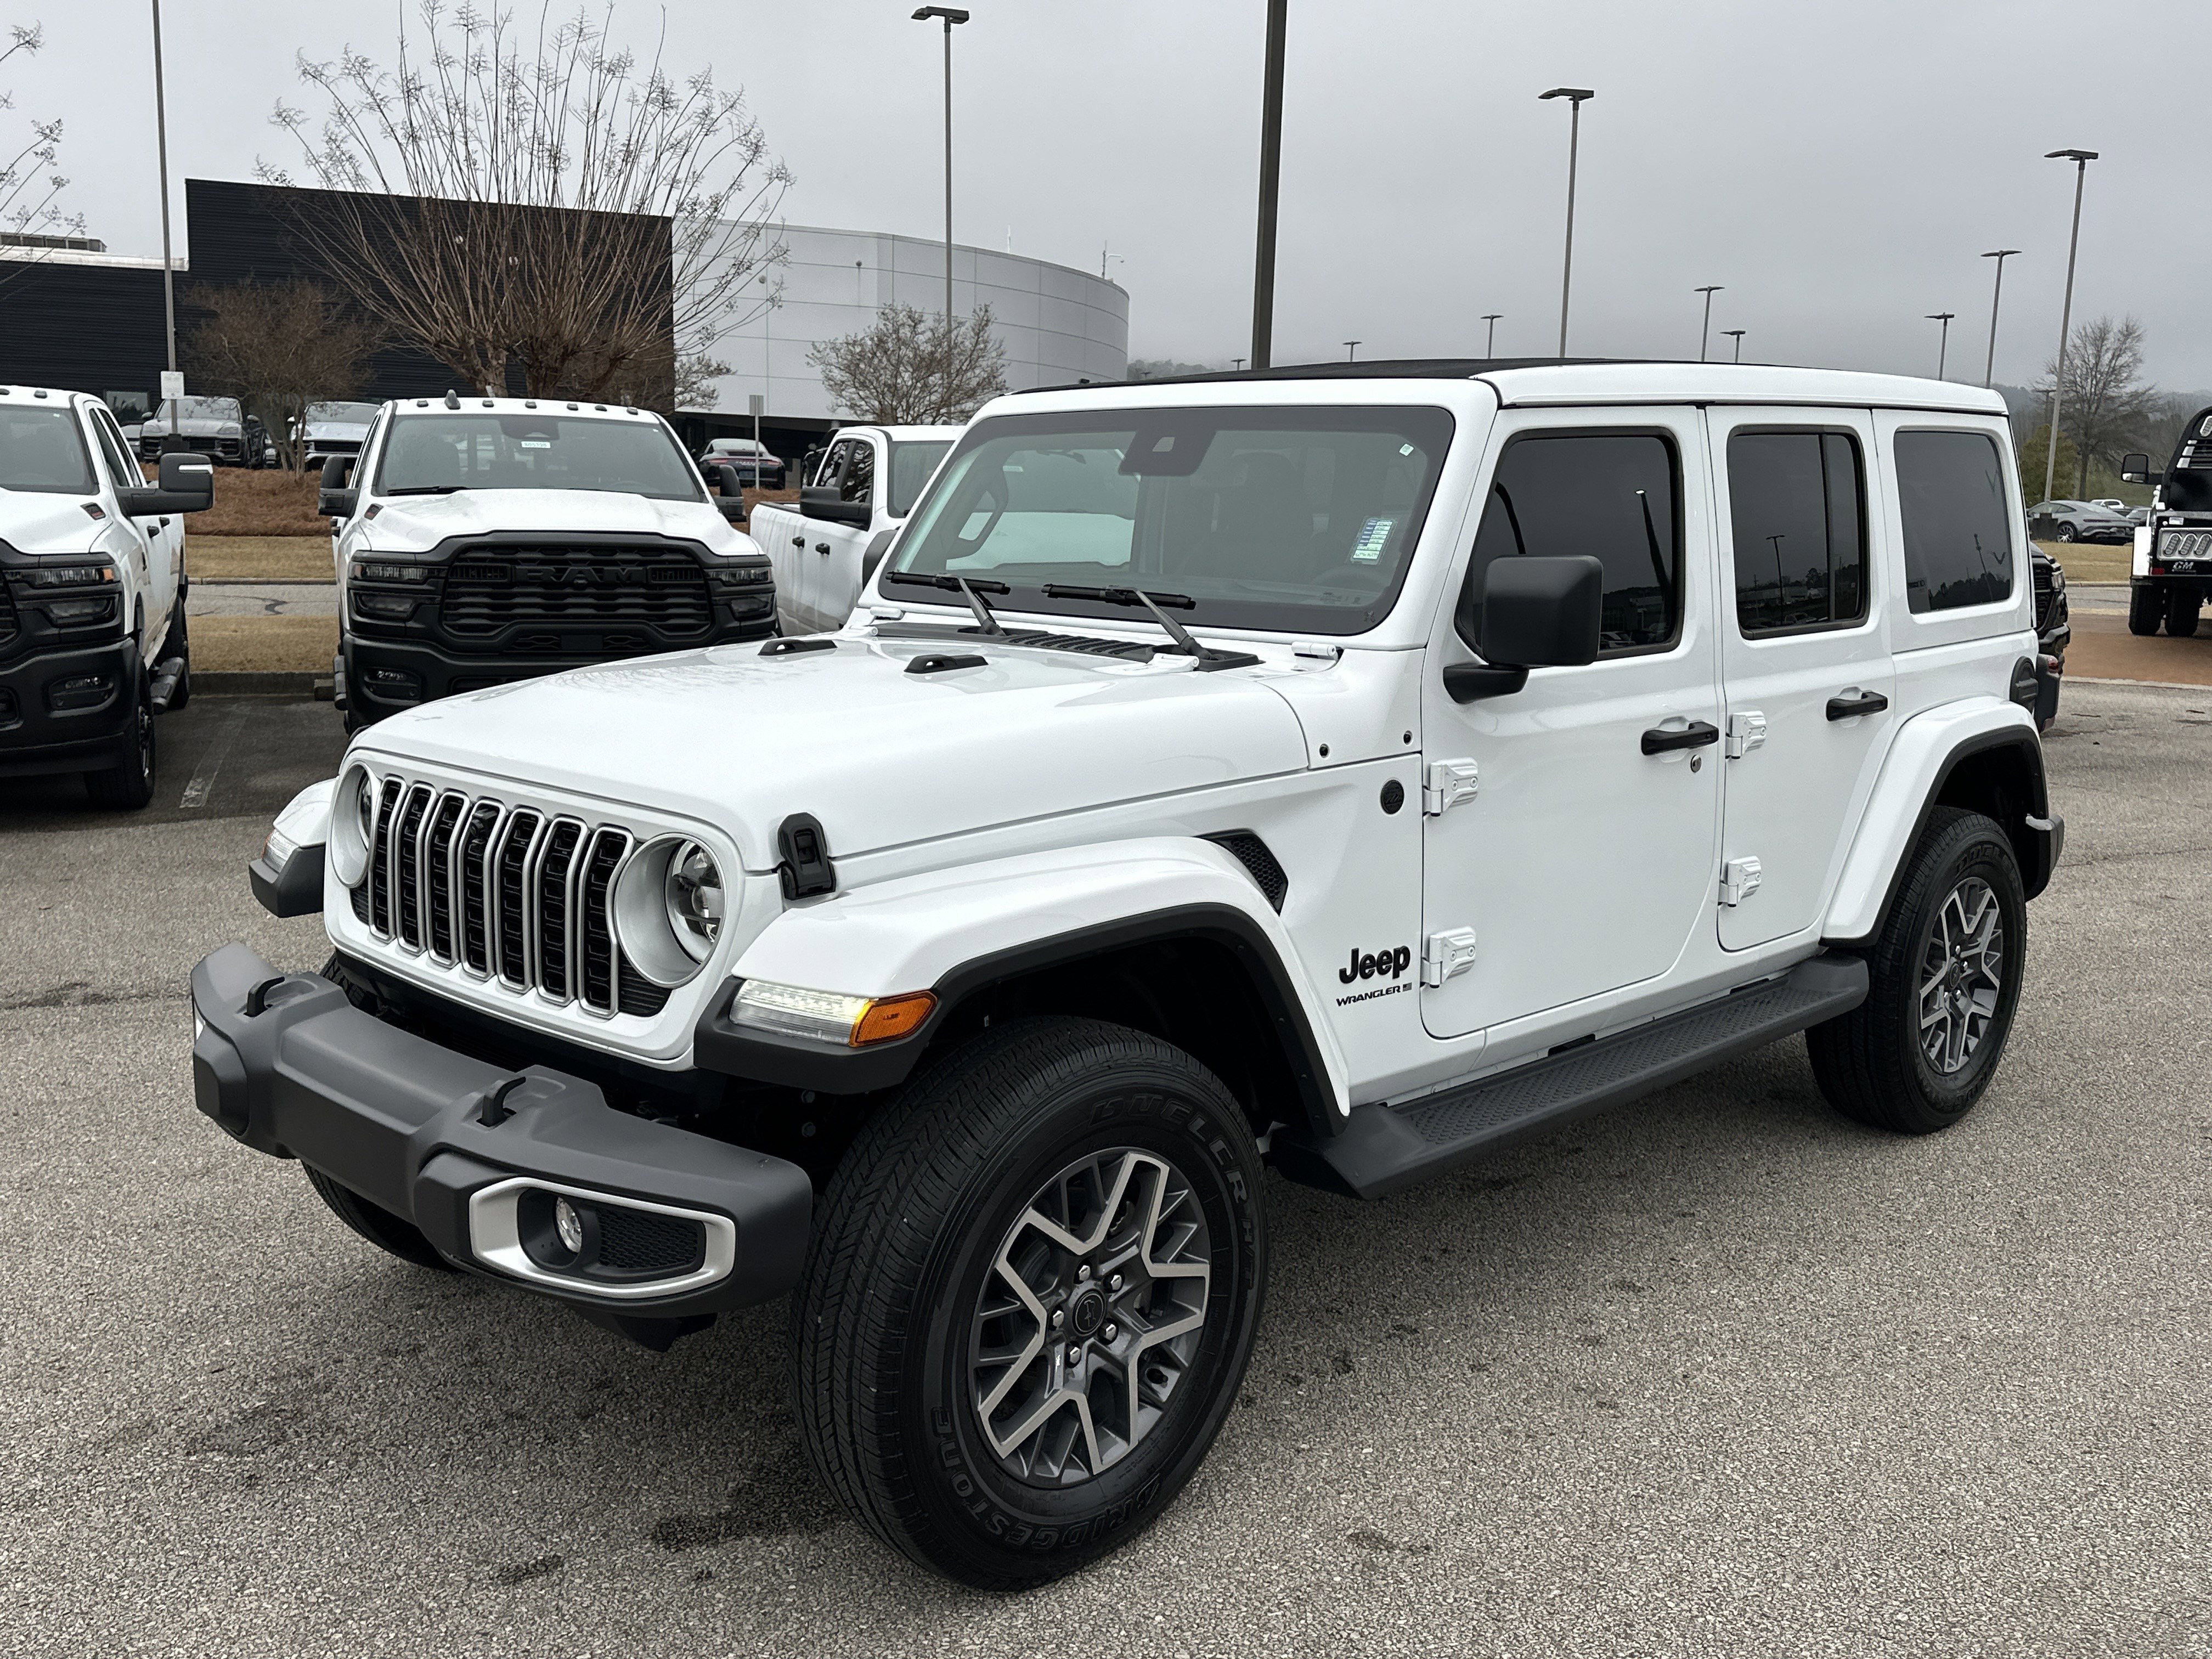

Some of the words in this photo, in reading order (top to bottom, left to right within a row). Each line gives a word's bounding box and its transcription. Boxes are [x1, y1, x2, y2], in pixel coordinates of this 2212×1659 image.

[515, 566, 644, 583] RAM
[1339, 945, 1411, 984] Jeep
[1335, 985, 1401, 1006] WRANGLER
[1088, 1092, 1249, 1204] DUELER
[930, 1404, 1161, 1551] BRIDGESTONE
